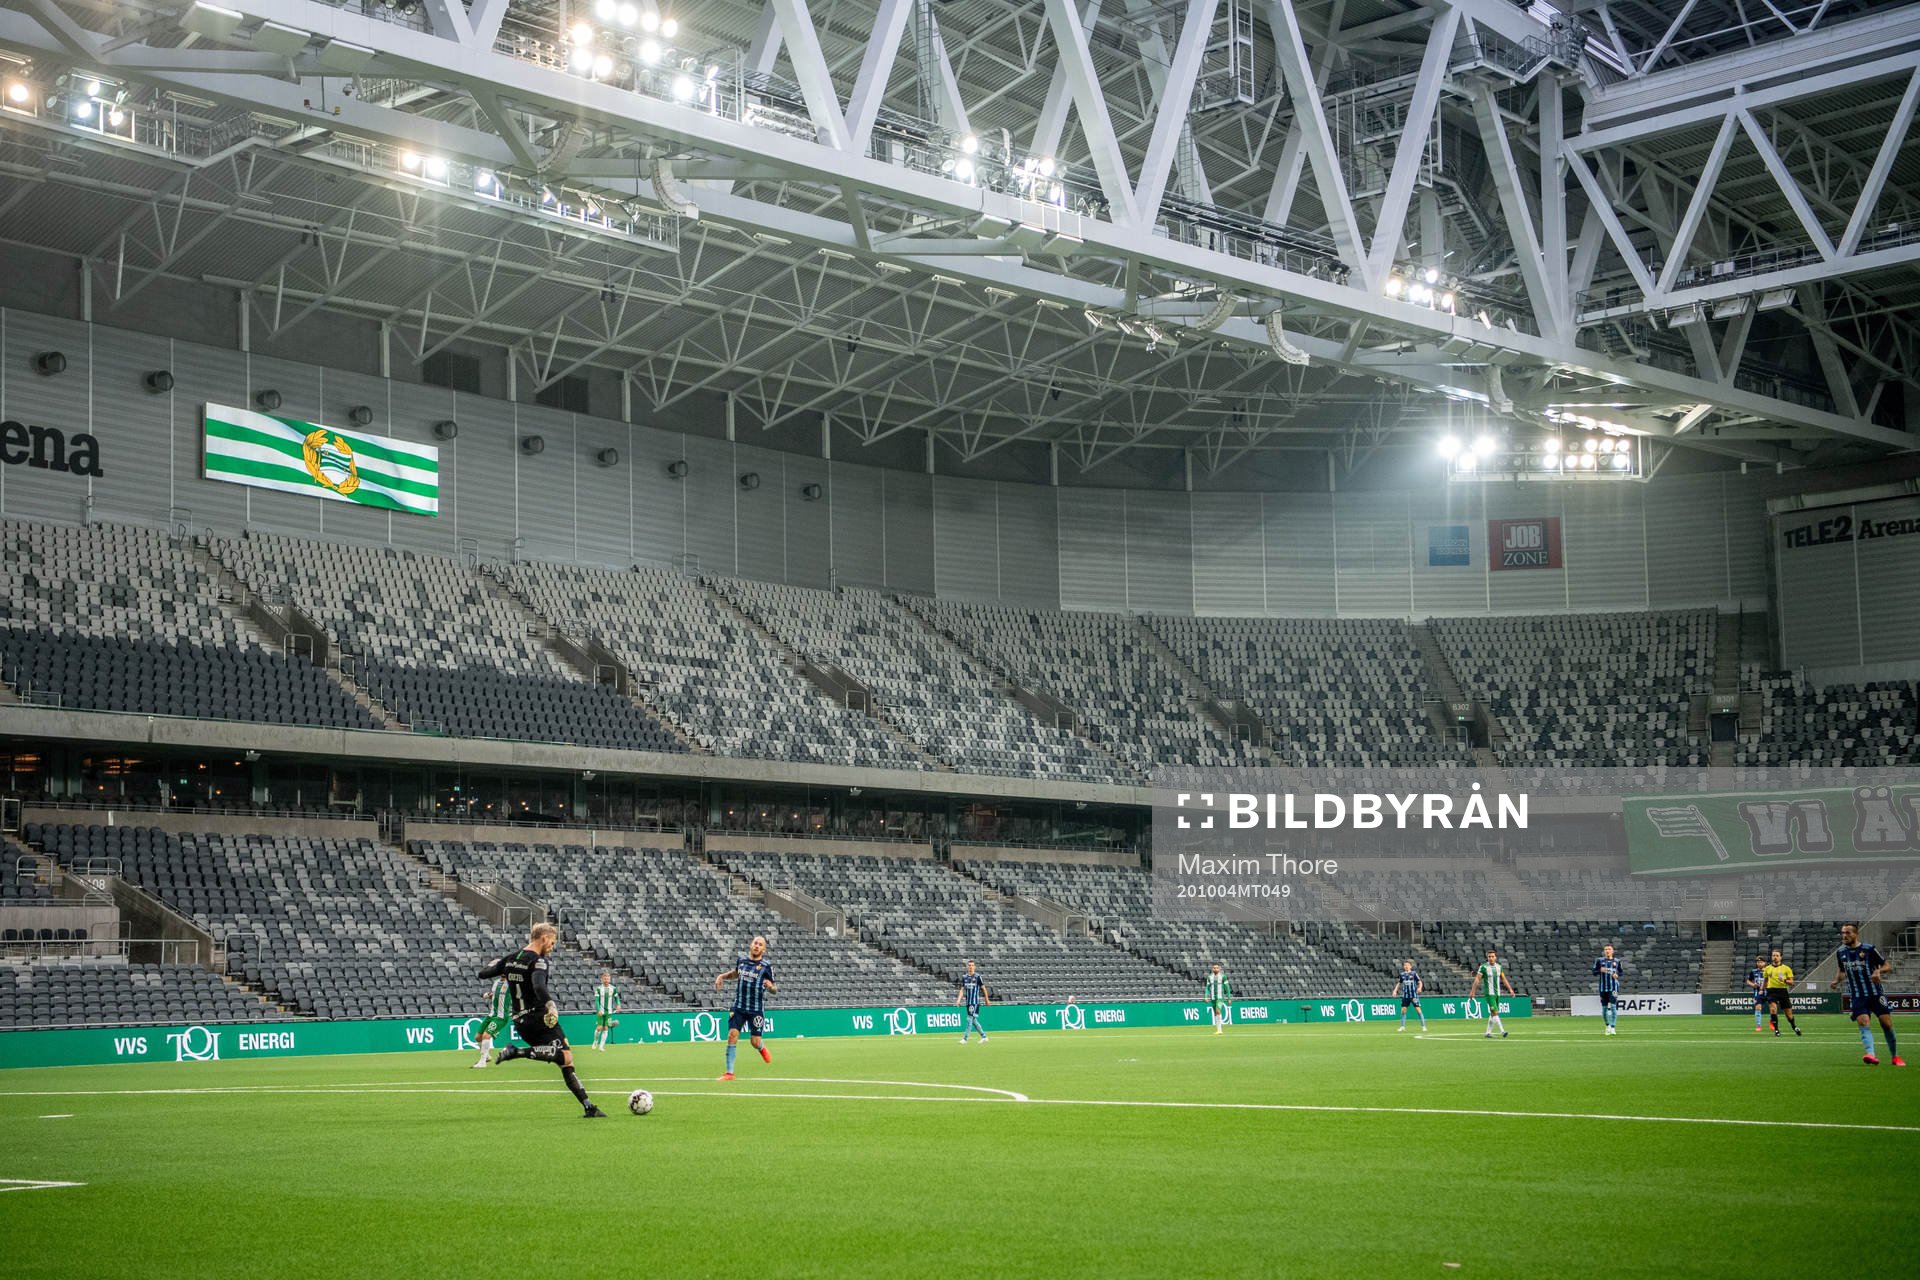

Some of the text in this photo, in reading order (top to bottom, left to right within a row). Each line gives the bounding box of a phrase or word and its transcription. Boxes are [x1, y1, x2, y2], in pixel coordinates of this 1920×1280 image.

[1505, 525, 1541, 549] JOB
[1783, 515, 1853, 549] TELE2
[1503, 552, 1549, 566] ZONE
[1741, 786, 1920, 852] VI Ä
[1184, 1008, 1199, 1020] VVS
[1240, 1006, 1268, 1019] ENERGI
[1320, 999, 1396, 1022] VVS TQI ENERGI
[1442, 1003, 1456, 1014] VVS
[1612, 999, 1656, 1011] RAFT
[1901, 999, 1910, 1008] &
[648, 1021, 671, 1036] VVS
[683, 1012, 721, 1042] TQI
[852, 1007, 961, 1035] VVS TQI ENERGI
[1029, 1004, 1125, 1030] VVS TQI ENERGI
[114, 1026, 295, 1062] VVS TQI ENERGI
[406, 1027, 434, 1044] VVS
[450, 1018, 494, 1051] TQ
